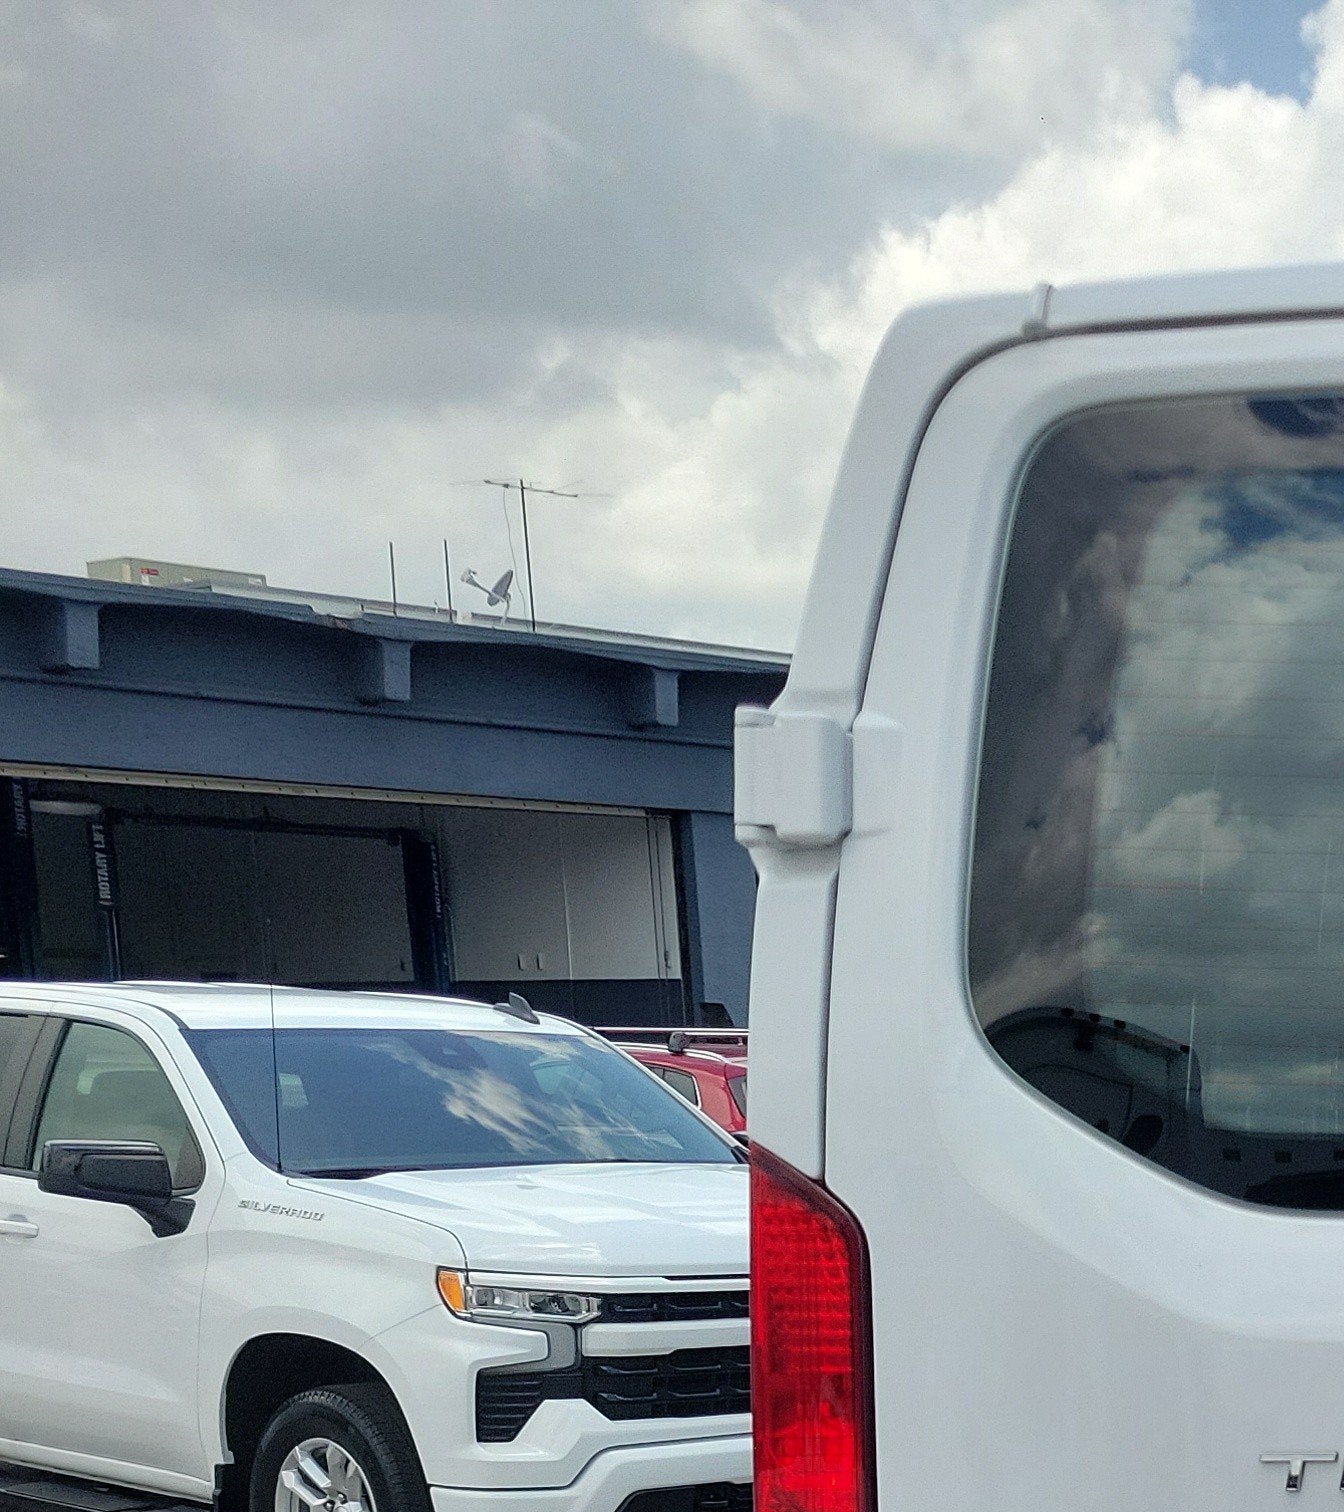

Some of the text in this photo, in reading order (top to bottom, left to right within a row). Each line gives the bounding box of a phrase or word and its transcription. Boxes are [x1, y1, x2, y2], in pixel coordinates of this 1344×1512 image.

[92, 825, 111, 899] ROTARY LIFT
[237, 1199, 325, 1221] SILVERADO
